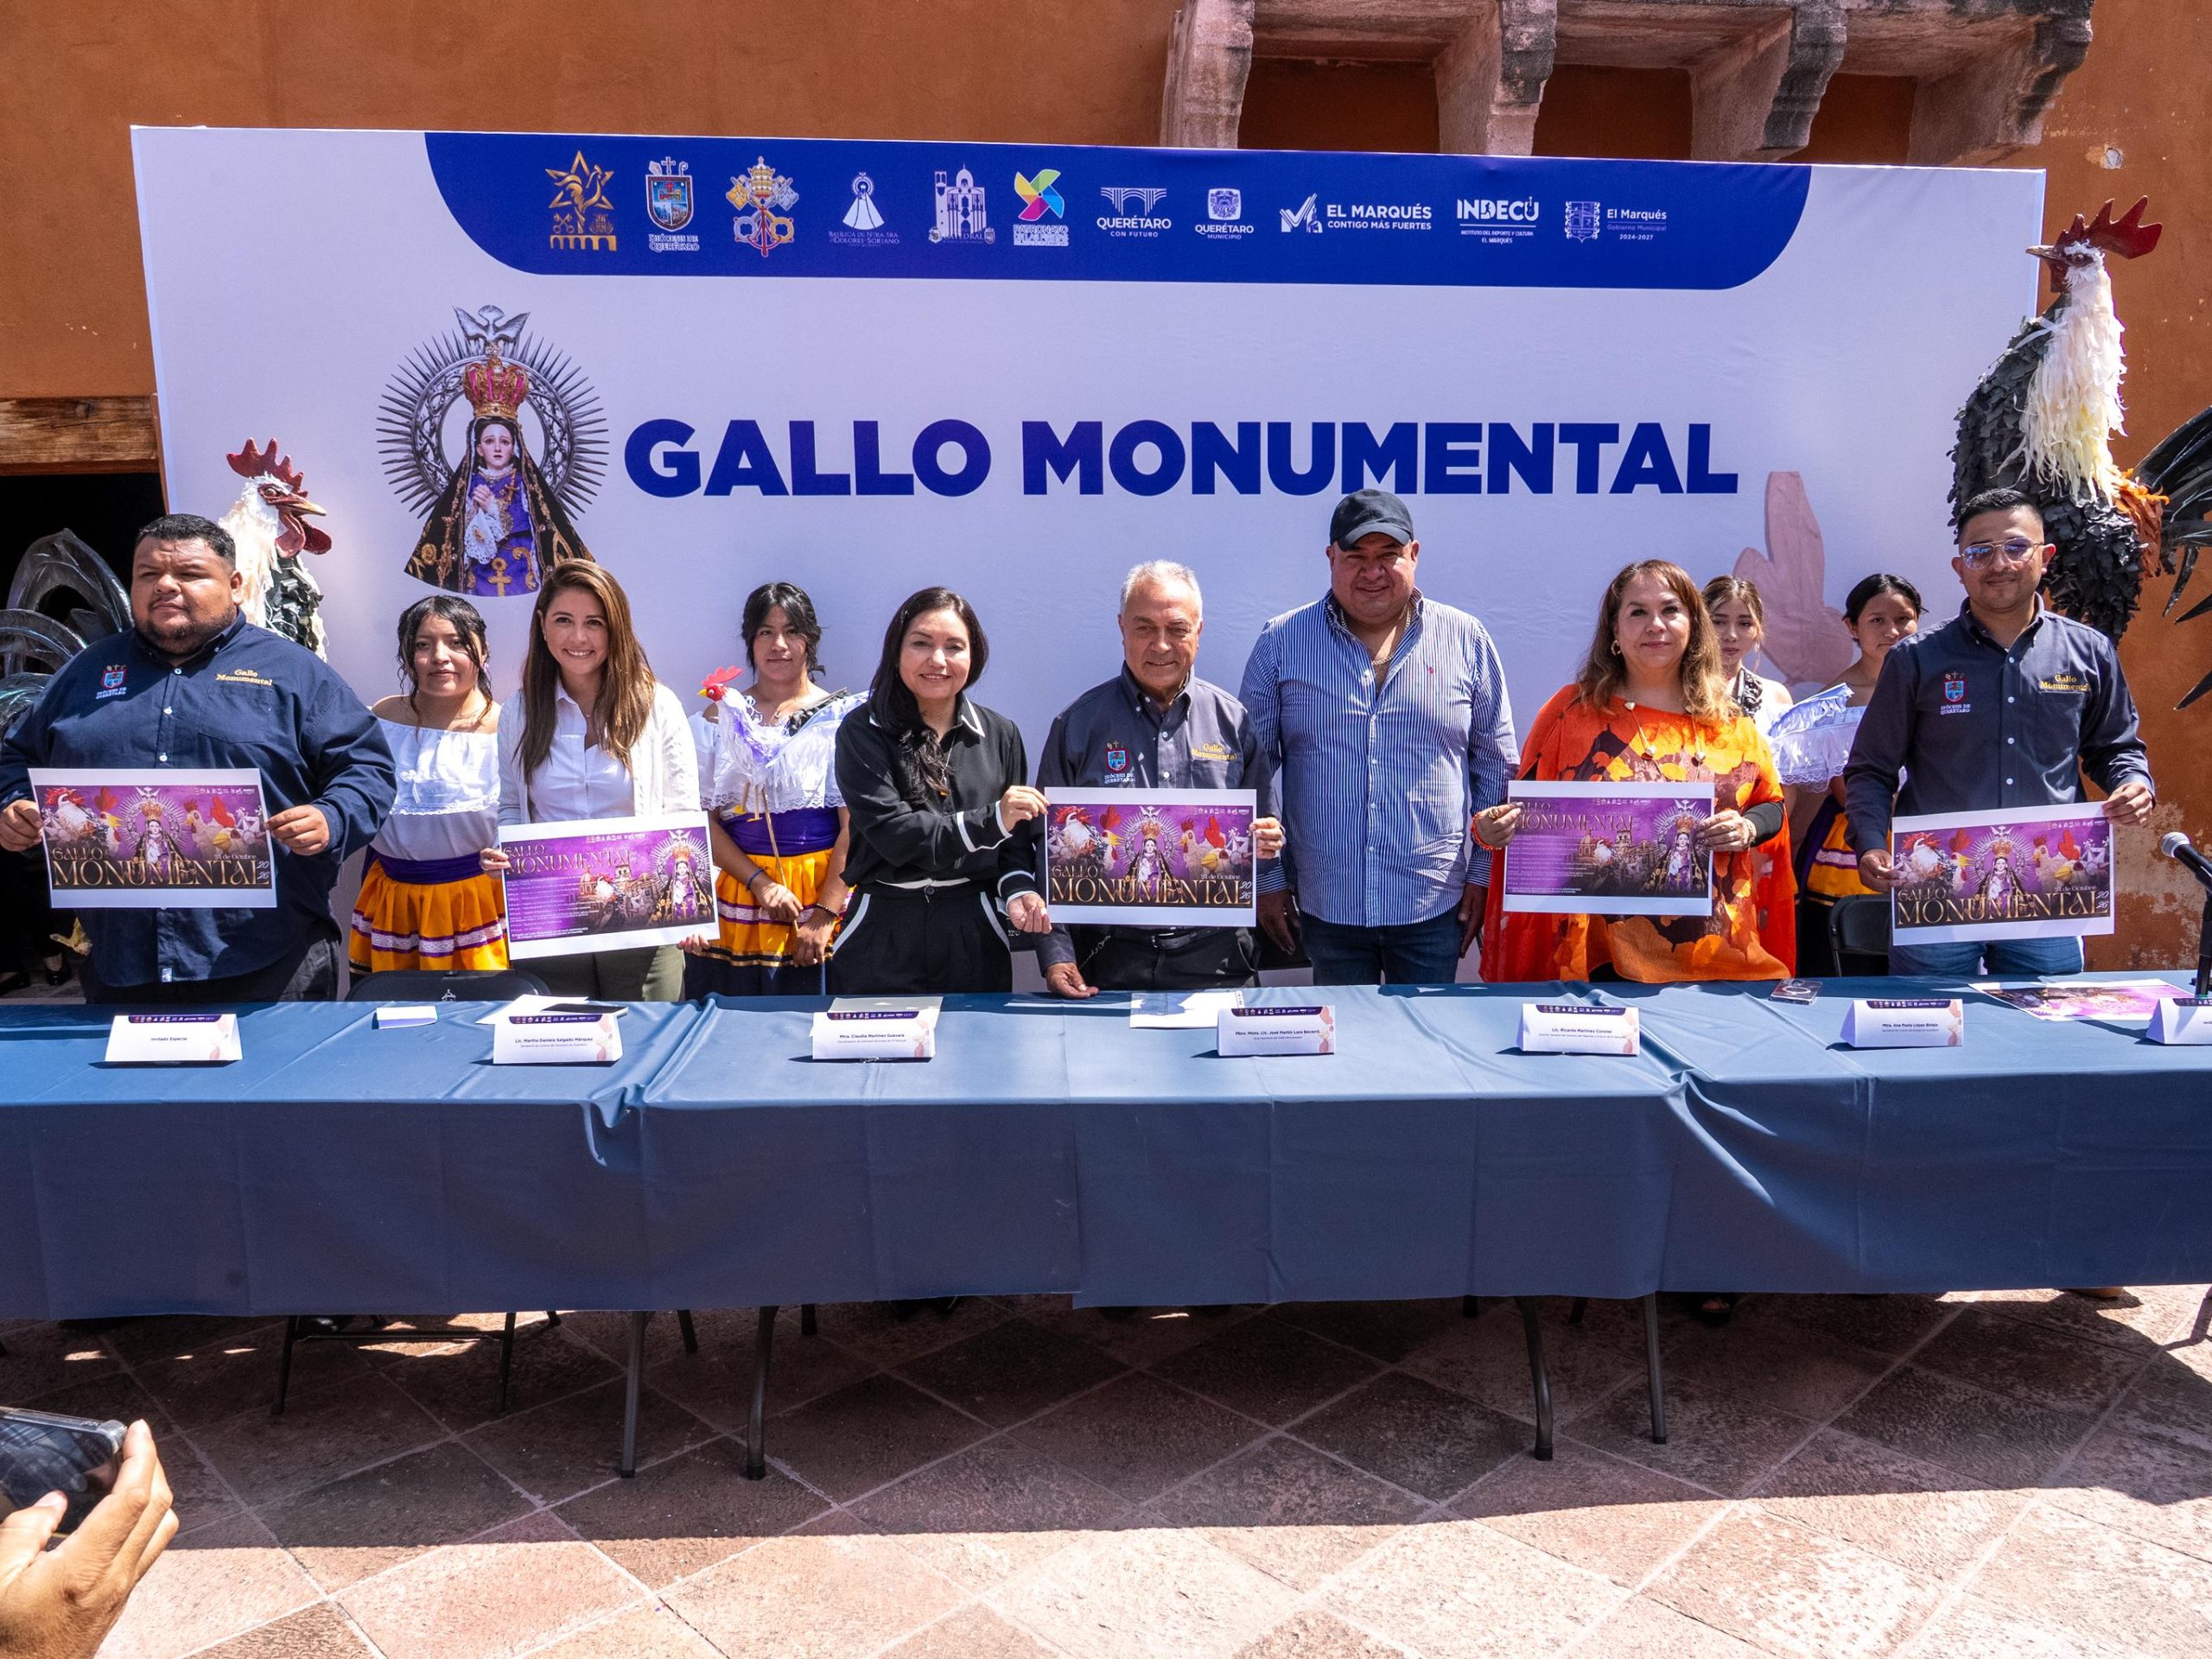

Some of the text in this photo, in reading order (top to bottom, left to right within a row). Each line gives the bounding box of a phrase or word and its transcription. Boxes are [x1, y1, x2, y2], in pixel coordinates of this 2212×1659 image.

[1327, 203, 1432, 219] EL MARQUÉS
[1607, 209, 1667, 221] El Marqués
[1096, 215, 1172, 230] QUERÉTARO
[1195, 222, 1254, 235] QUERÉTARO
[1371, 220, 1390, 229] MÁS
[624, 418, 1738, 498] GALLO MONUMENTAL
[234, 669, 258, 677] Gallo
[216, 674, 273, 686] Monumental
[1203, 743, 1223, 752] Gallo
[52, 847, 103, 861] GALLO
[503, 844, 546, 858] GALLO
[257, 861, 269, 869] 20
[505, 849, 632, 875] MONUMENTAL
[52, 860, 270, 886] MONUMENTAL
[1052, 865, 1098, 878] GALLO
[1052, 877, 1251, 904] MONUMENTAL
[1239, 881, 1252, 890] 20
[1898, 887, 1946, 901] GALLO
[2095, 890, 2109, 899] 20
[1898, 890, 2108, 925] MONUMENTAL
